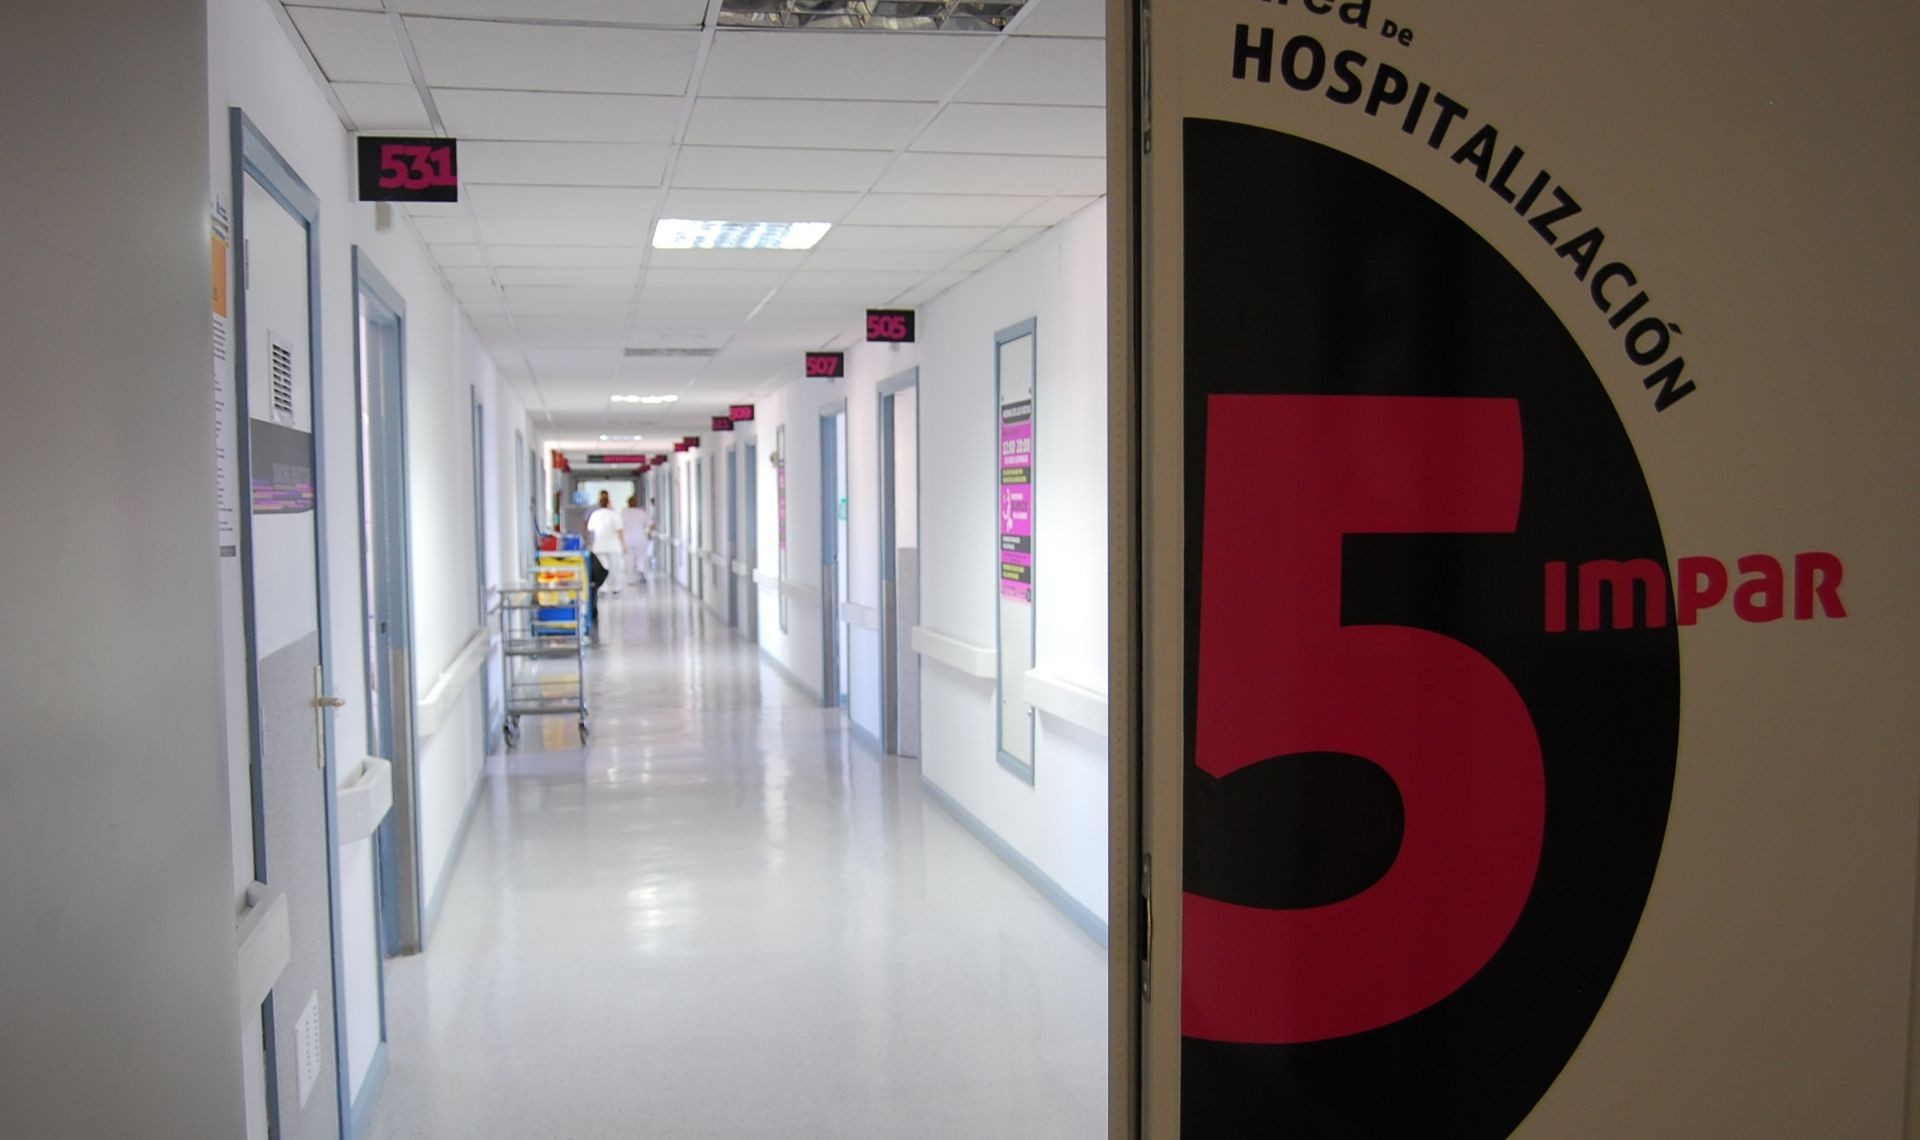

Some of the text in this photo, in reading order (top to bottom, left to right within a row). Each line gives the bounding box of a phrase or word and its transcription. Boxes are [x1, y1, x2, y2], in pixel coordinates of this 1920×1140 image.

[378, 144, 458, 190] 531
[1232, 23, 1697, 413] HOSPITALIZACIÓN
[866, 315, 907, 340] 505
[805, 356, 839, 376] 507
[1181, 394, 1546, 1044] 5
